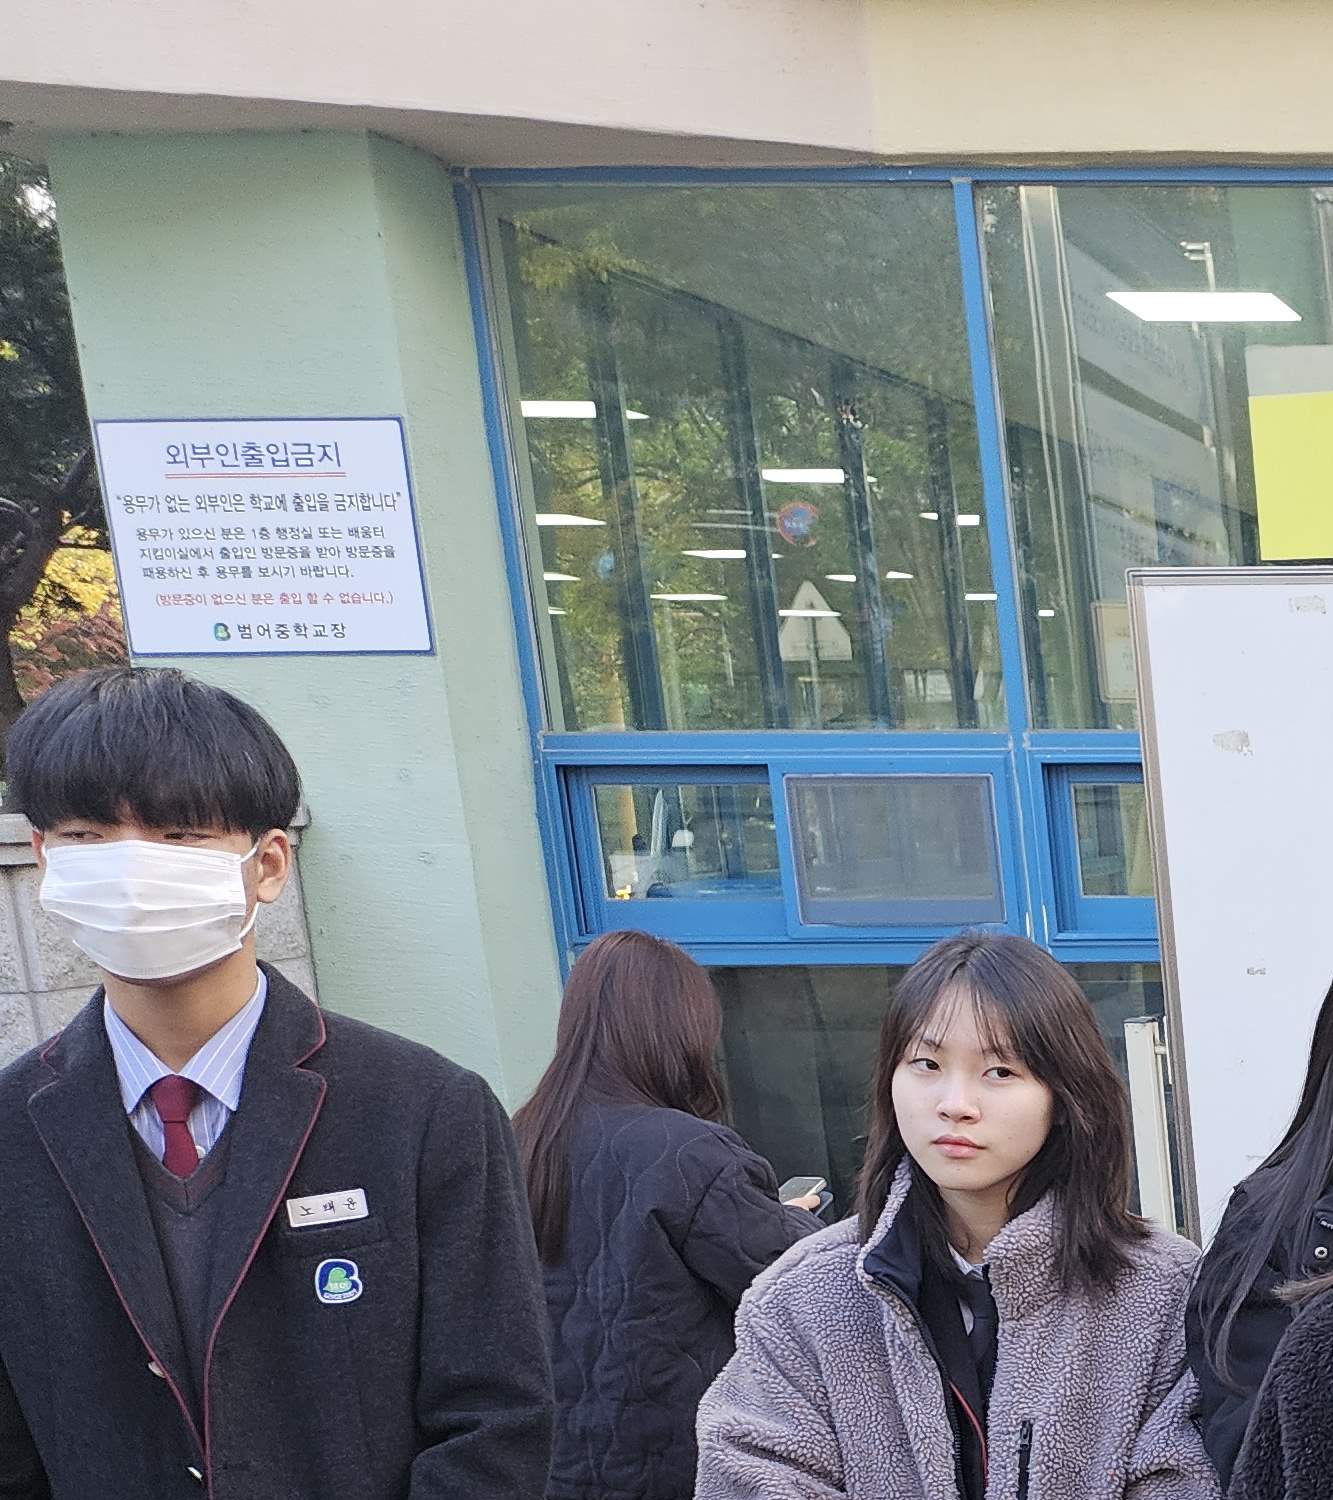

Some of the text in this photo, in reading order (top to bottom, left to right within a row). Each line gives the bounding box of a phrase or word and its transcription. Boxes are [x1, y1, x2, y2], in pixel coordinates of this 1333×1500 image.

[166, 442, 342, 468] 외부인출입금지
[165, 494, 190, 513] 없는
[195, 494, 245, 513] 외부인은
[249, 493, 288, 512] 학교에
[292, 493, 329, 512] 출입을
[136, 528, 173, 541] 용무가
[178, 527, 216, 540] 있으신
[221, 527, 246, 540] 분은
[318, 526, 343, 539] 또는
[347, 525, 385, 539] 배움터
[261, 546, 311, 559] 방문증을
[315, 546, 341, 559] 받아
[345, 545, 395, 559] 방문증을
[198, 566, 210, 579] 후
[215, 566, 252, 579] 용무를
[258, 565, 296, 578] 보시기
[300, 564, 355, 578] 바랍니다.
[211, 592, 247, 605] 없으신
[251, 592, 275, 605] 분은
[323, 592, 334, 605] 수
[237, 622, 346, 639] 범어중학교장
